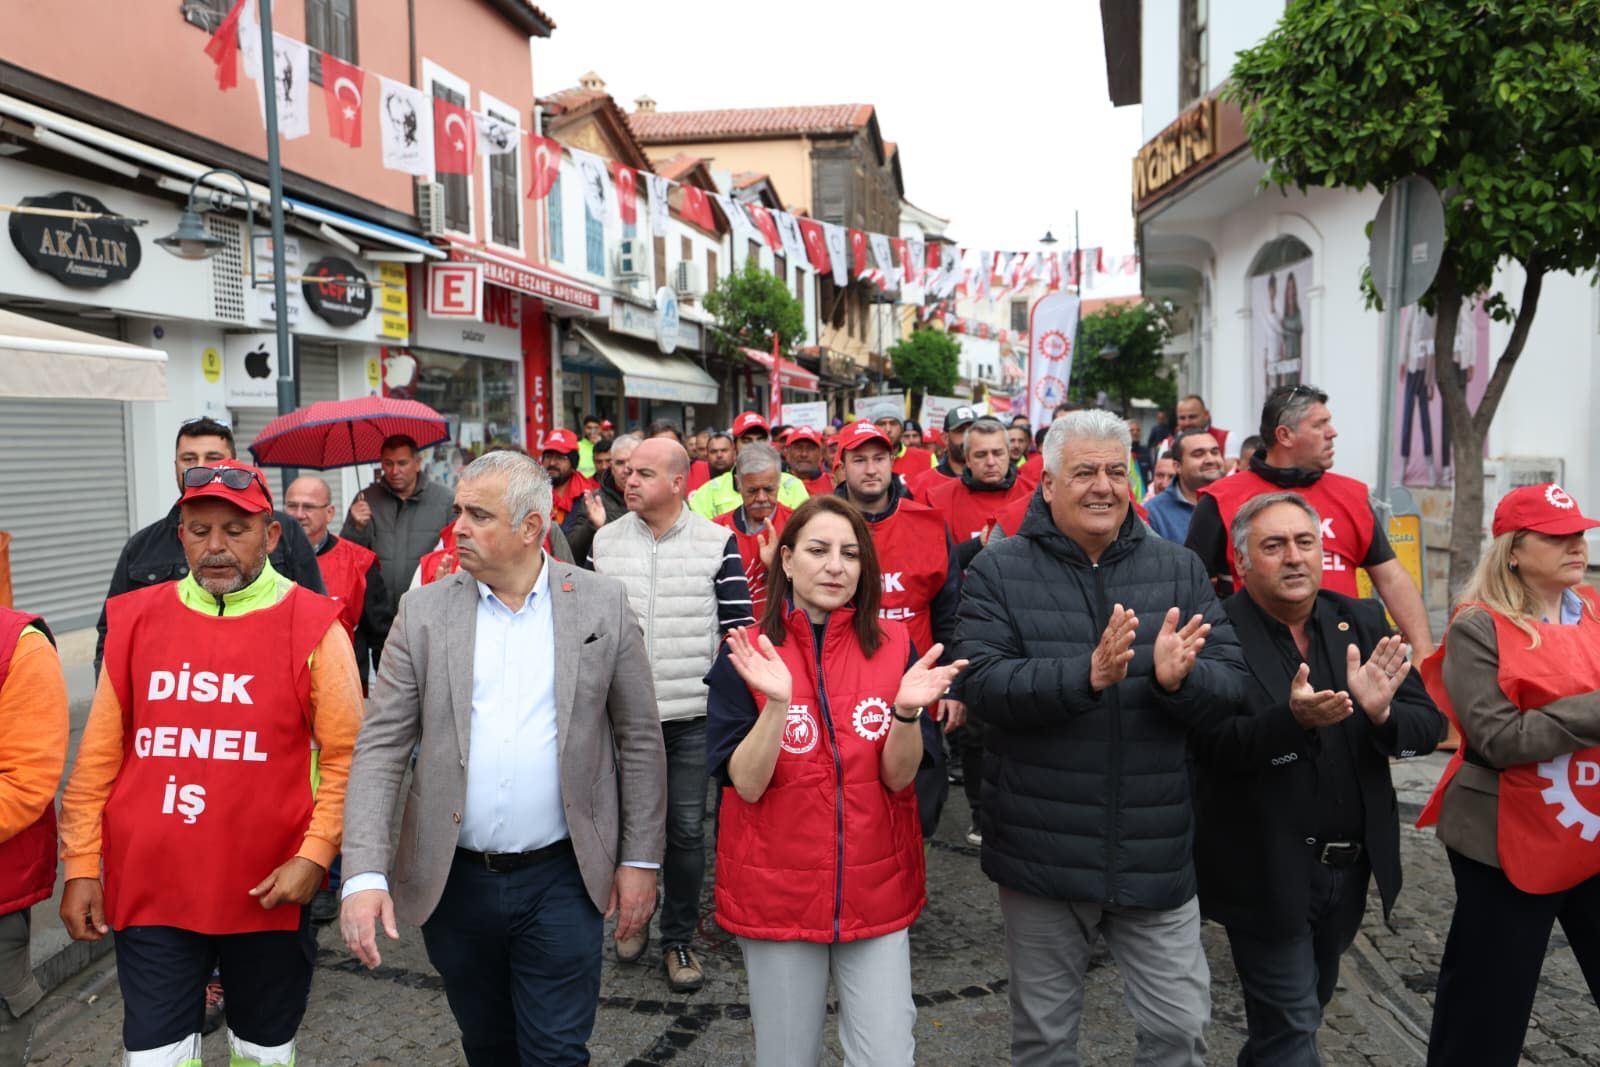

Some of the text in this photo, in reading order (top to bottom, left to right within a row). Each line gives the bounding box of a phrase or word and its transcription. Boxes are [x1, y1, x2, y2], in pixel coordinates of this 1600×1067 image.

[39, 227, 128, 268] AKALIN
[442, 274, 465, 308] E
[518, 272, 552, 296] ECZANE
[147, 662, 256, 705] DİSK
[134, 726, 268, 762] GENEL
[161, 774, 207, 825] İŞ
